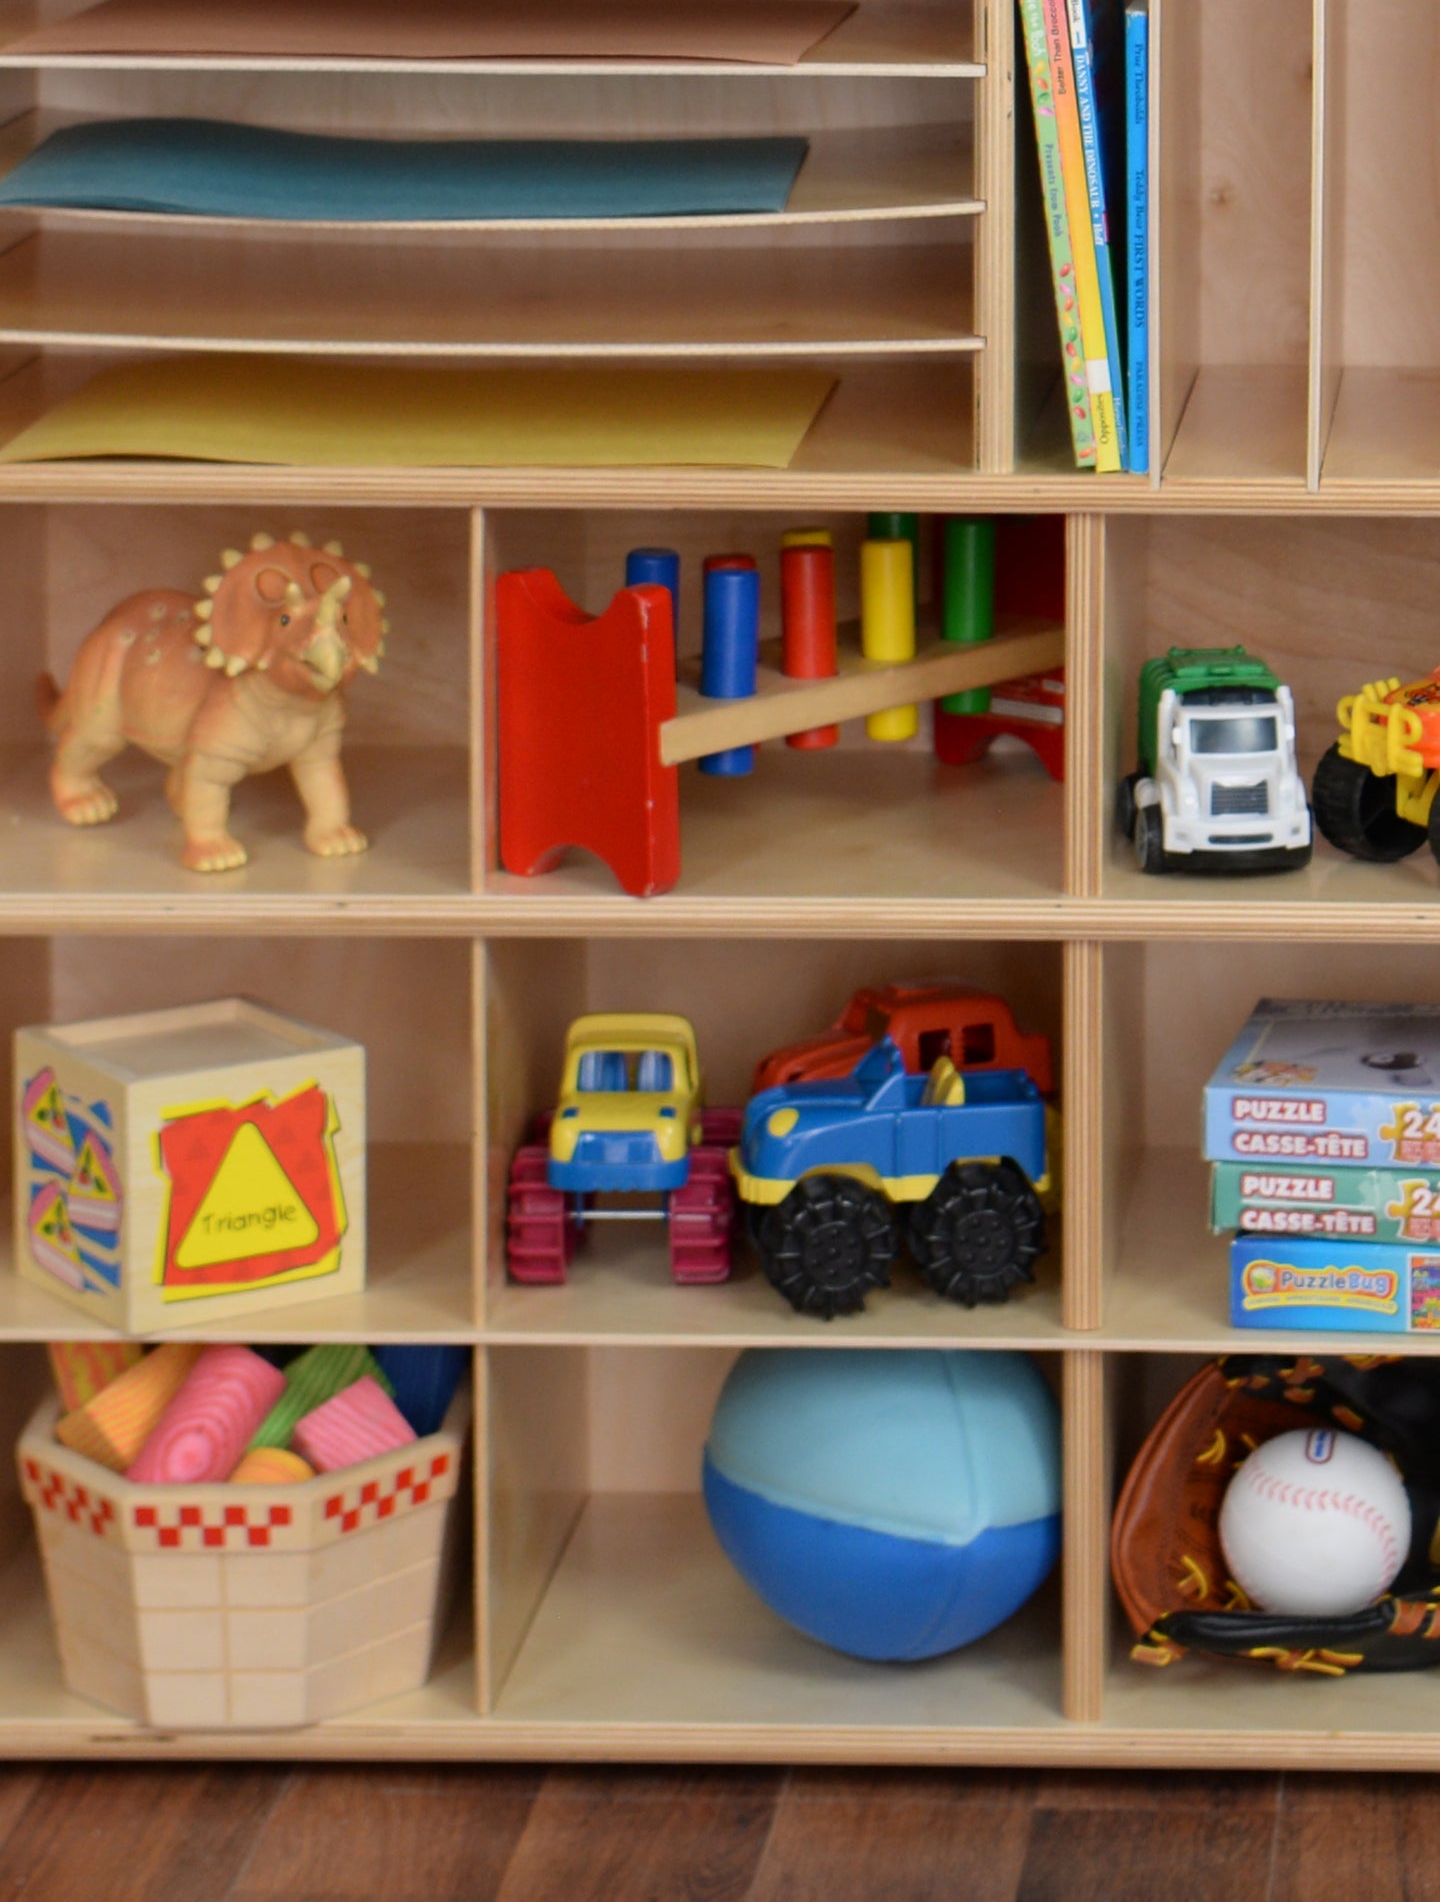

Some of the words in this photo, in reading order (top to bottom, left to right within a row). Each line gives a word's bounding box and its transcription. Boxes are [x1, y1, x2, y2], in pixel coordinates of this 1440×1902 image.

[1053, 38, 1063, 62] Than
[1056, 65, 1066, 95] Better
[1075, 53, 1089, 94] DANNY
[1080, 96, 1092, 121] AND
[1082, 123, 1095, 147] THE
[1085, 148, 1101, 209] DINOSAUR
[1133, 170, 1144, 202] Teddy
[1134, 205, 1144, 229] Bear
[1093, 223, 1104, 246] Hoff
[1134, 233, 1144, 275] FIRST
[1134, 277, 1145, 329] WORDS
[1135, 416, 1144, 447] PRESS
[1235, 1099, 1324, 1122] PUZZLE
[1234, 1132, 1367, 1158] CASSE-TÊTE
[1242, 1175, 1333, 1200] PUZZLE
[202, 1201, 298, 1236] Triangle
[1241, 1209, 1375, 1234] CASSE-TÊTE
